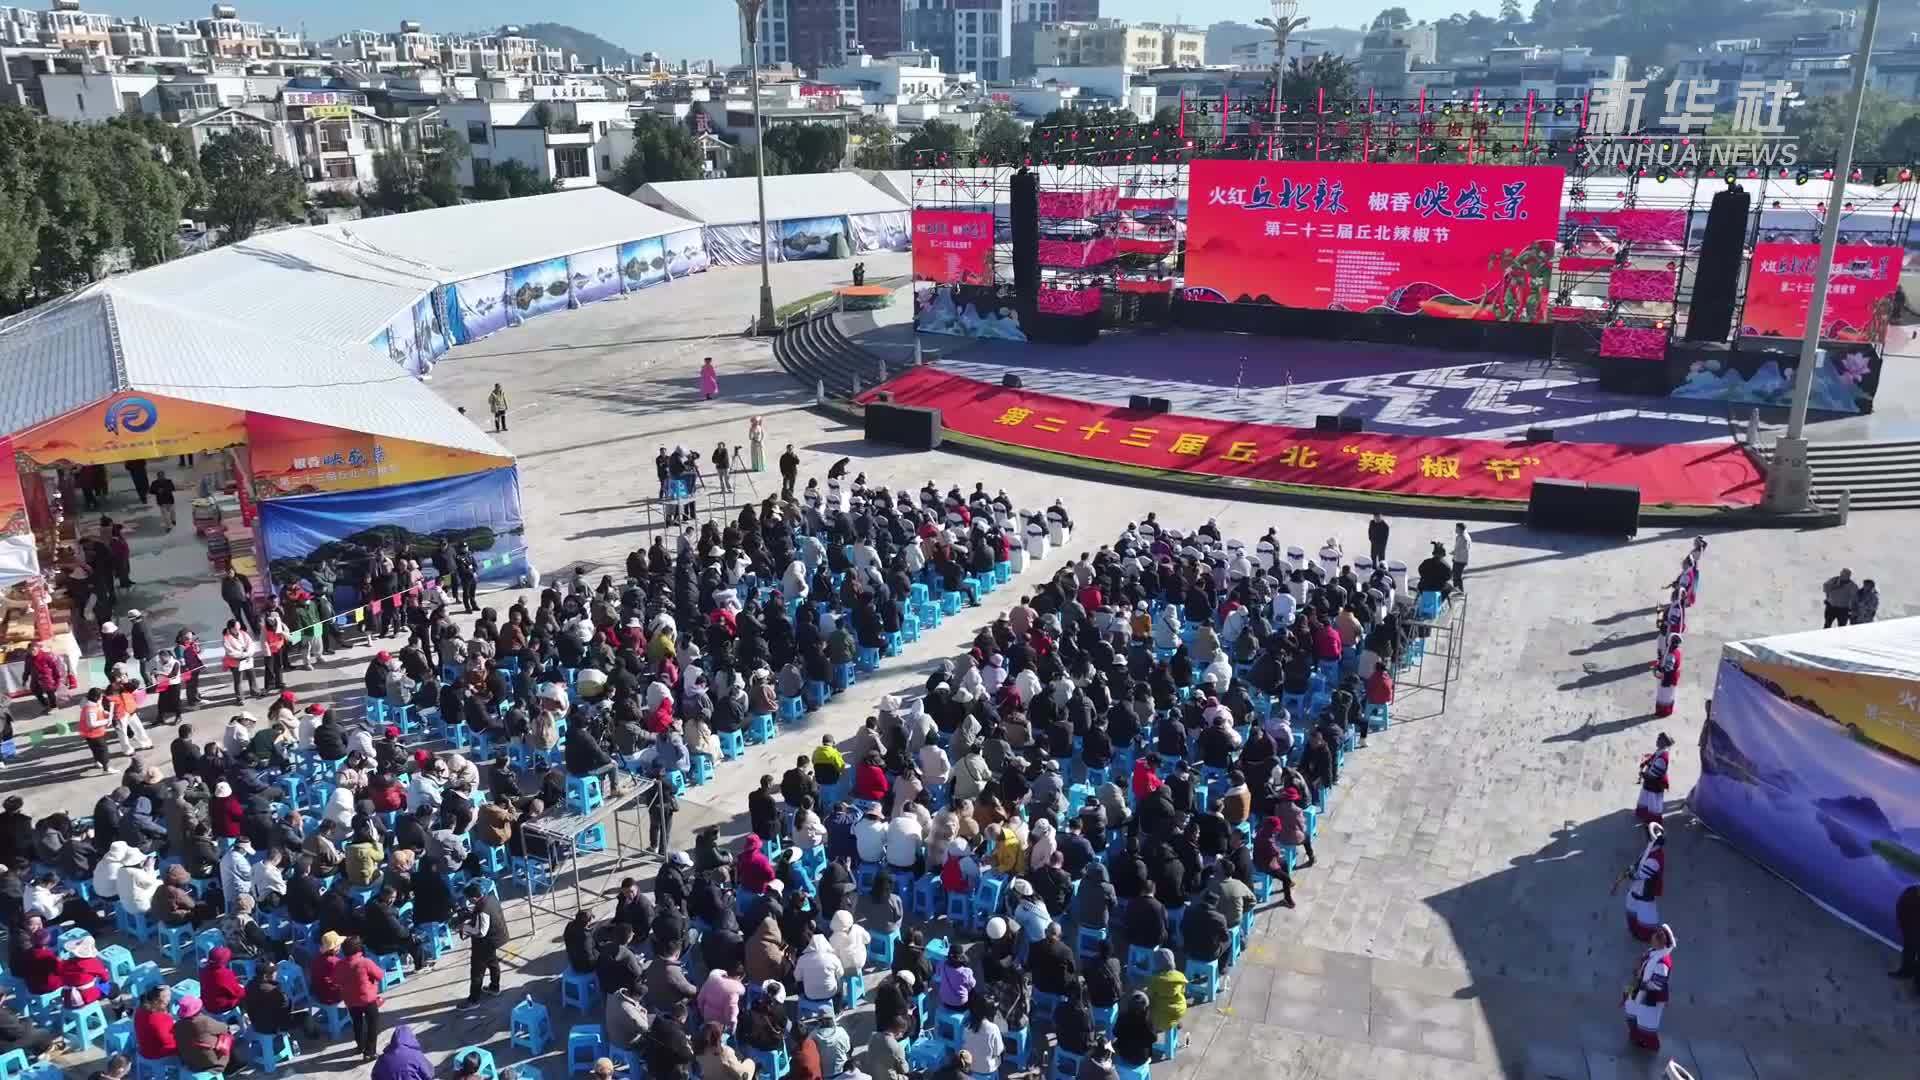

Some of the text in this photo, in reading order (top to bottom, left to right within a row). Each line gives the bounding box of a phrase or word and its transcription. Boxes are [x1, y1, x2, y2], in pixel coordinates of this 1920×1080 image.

[1264, 221, 1450, 244] 第二十三届丘北辣椒节
